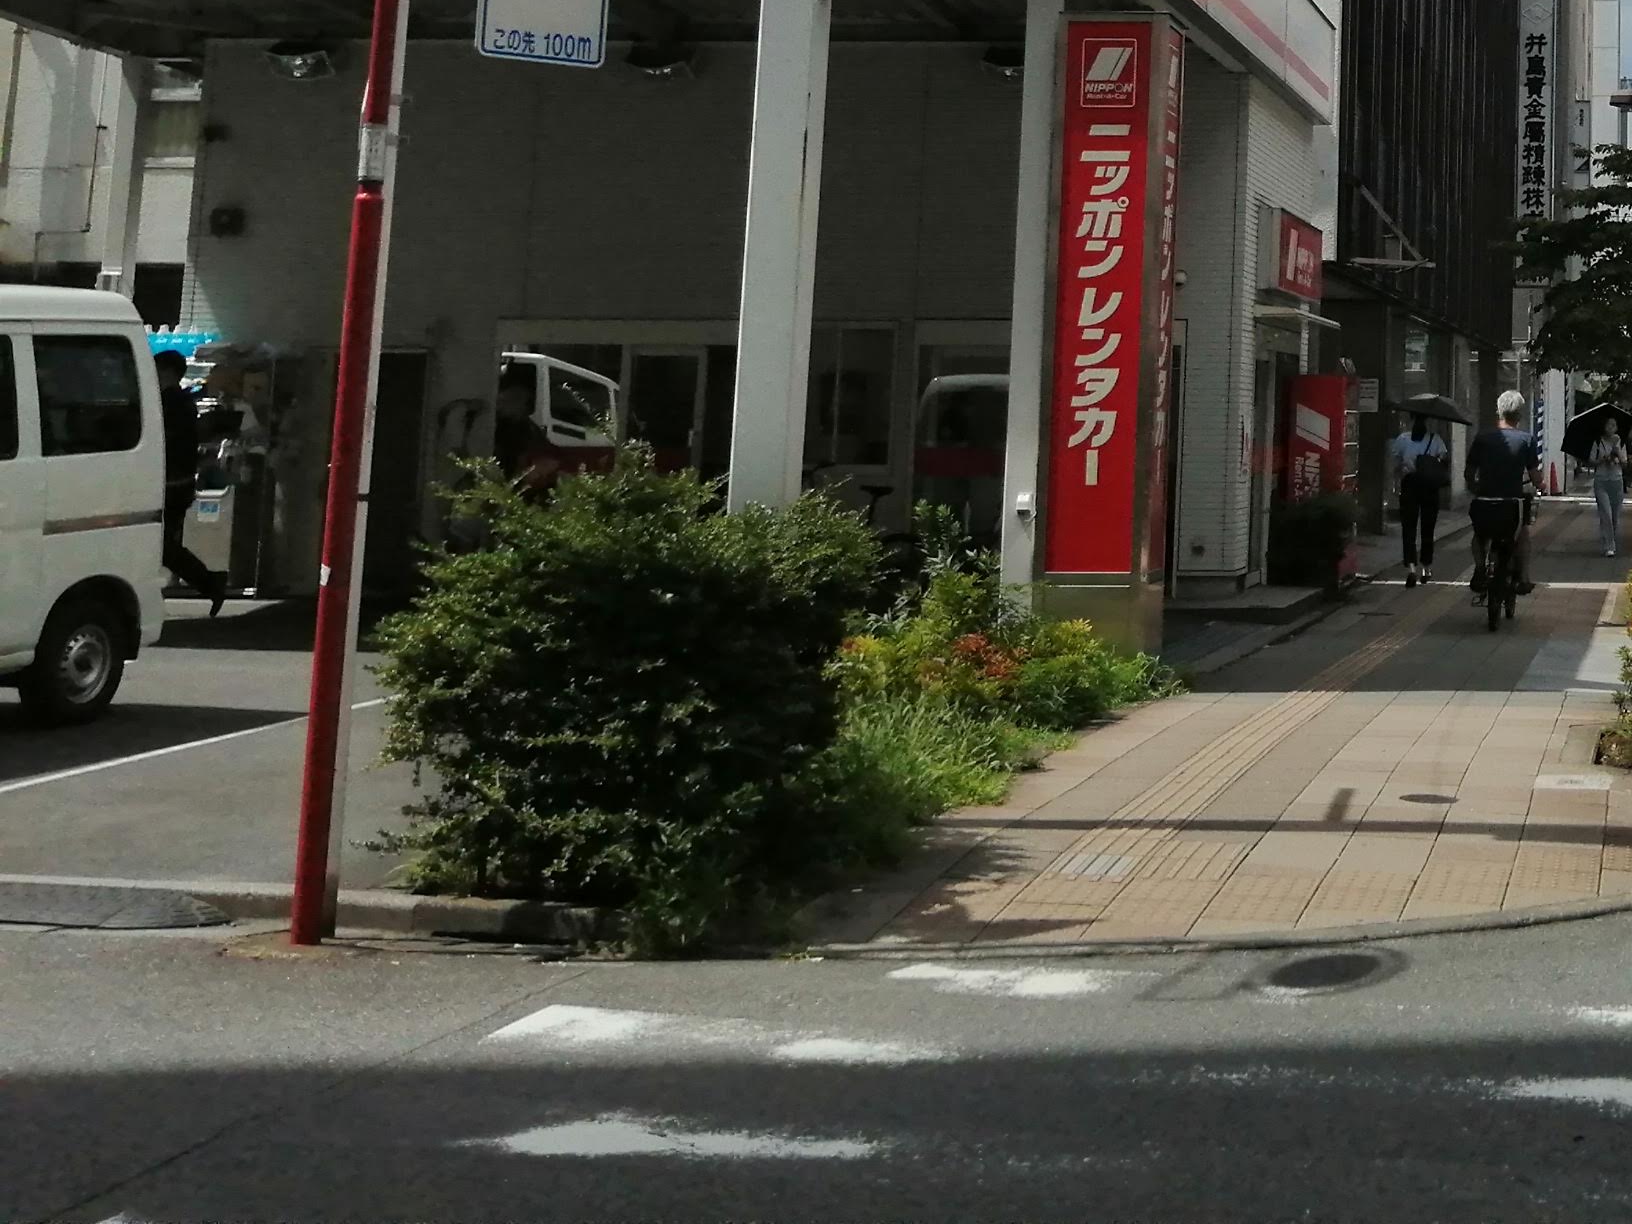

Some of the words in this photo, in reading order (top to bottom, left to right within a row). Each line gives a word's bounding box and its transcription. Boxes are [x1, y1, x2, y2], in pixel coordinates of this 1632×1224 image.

[543, 33, 592, 60] 100m
[1084, 82, 1134, 94] NIPPON
[1068, 124, 1132, 486] ニッポンレンタカー
